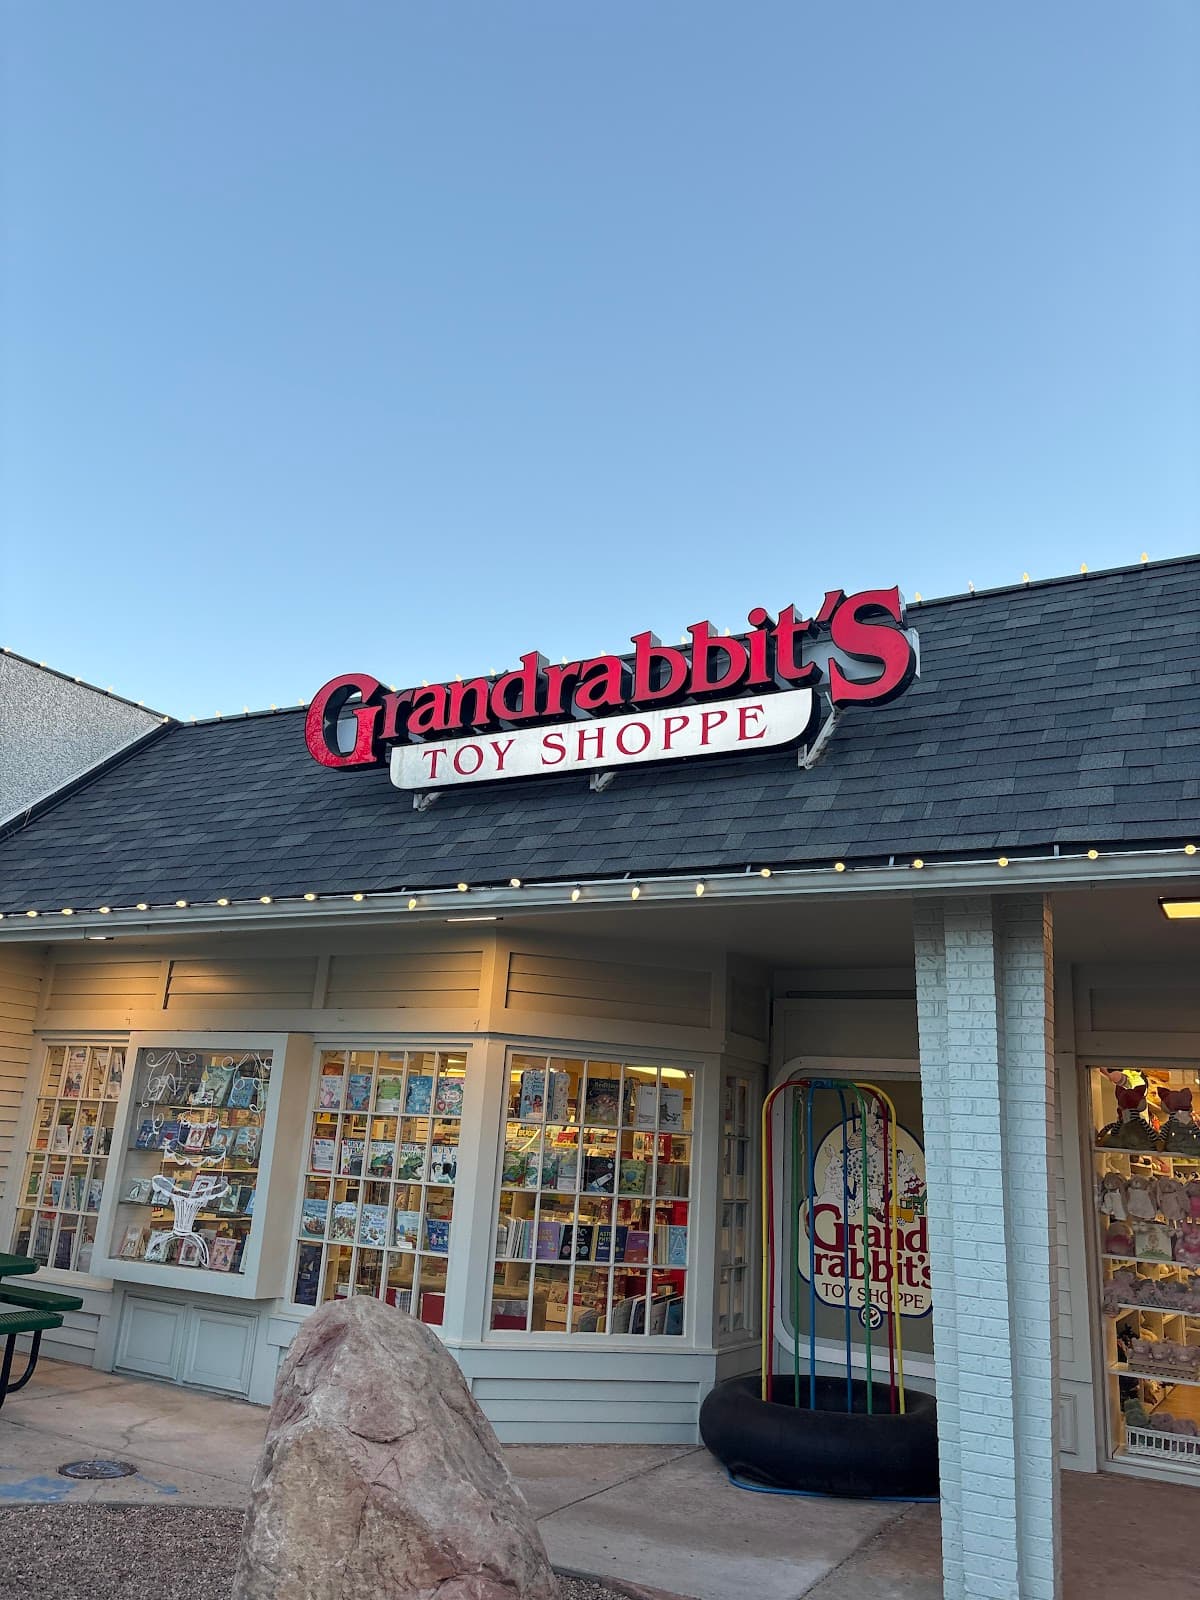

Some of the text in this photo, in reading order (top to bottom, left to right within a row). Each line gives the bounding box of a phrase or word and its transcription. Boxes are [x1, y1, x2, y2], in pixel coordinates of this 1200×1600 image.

[422, 703, 768, 780] TOY SHOPPE
[806, 1203, 928, 1253] Grand
[814, 1247, 932, 1290] rabbit's
[857, 1286, 925, 1310] SHOPPE
